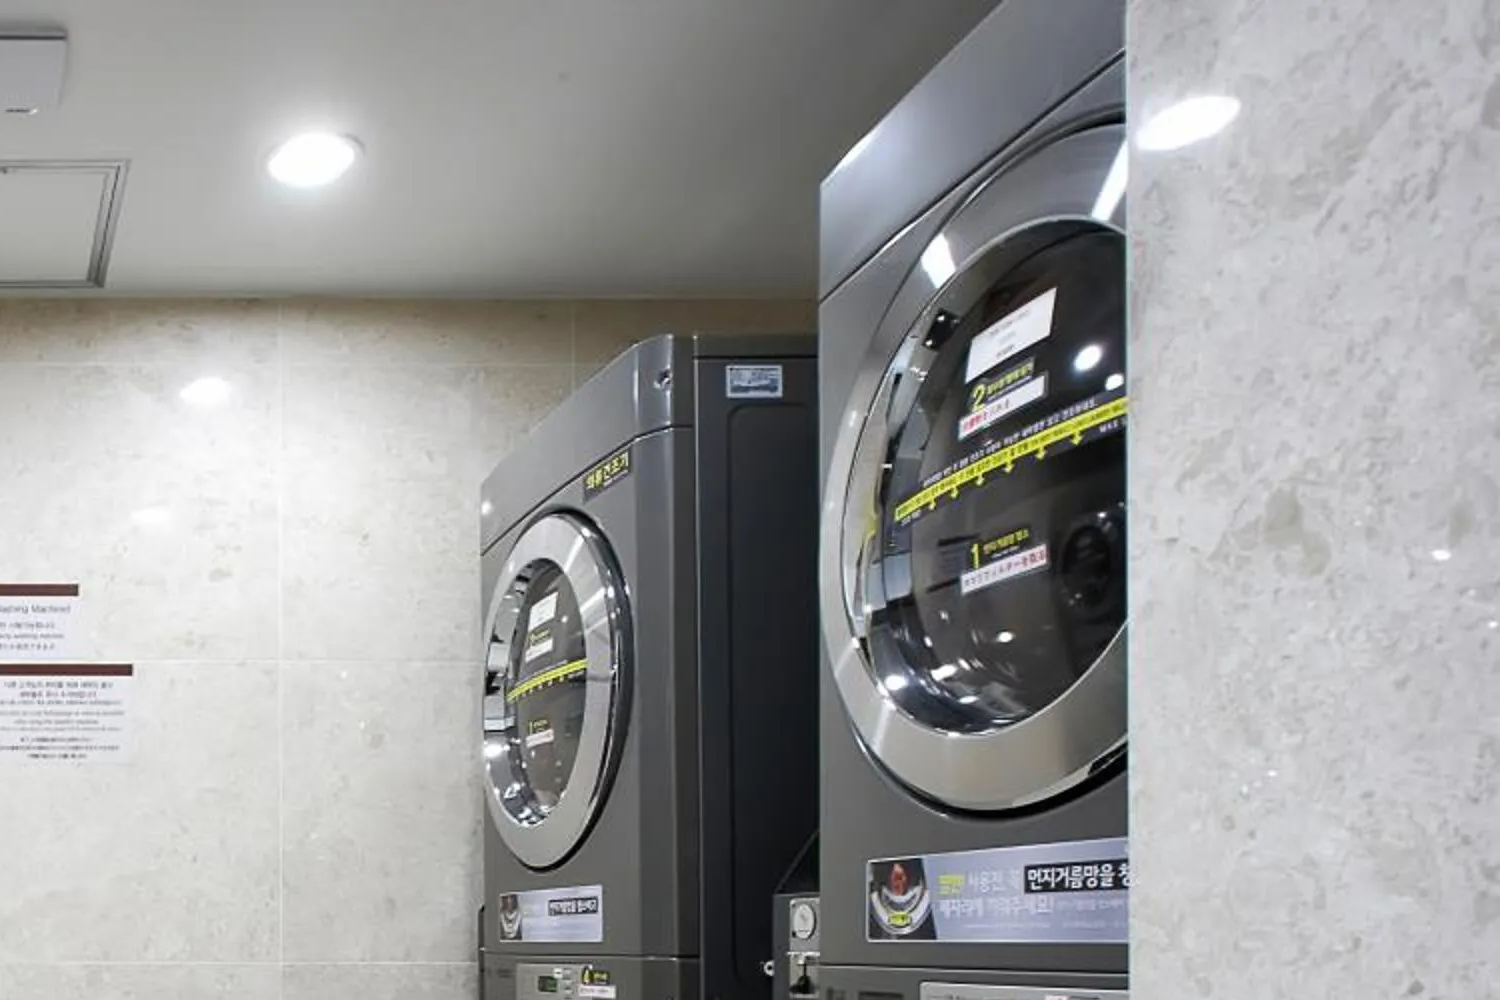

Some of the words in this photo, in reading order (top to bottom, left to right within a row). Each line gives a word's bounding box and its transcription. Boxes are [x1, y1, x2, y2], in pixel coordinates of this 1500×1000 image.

[972, 383, 986, 412] 2
[971, 543, 980, 569] 1
[1027, 863, 1114, 890] 먼지거름망을
